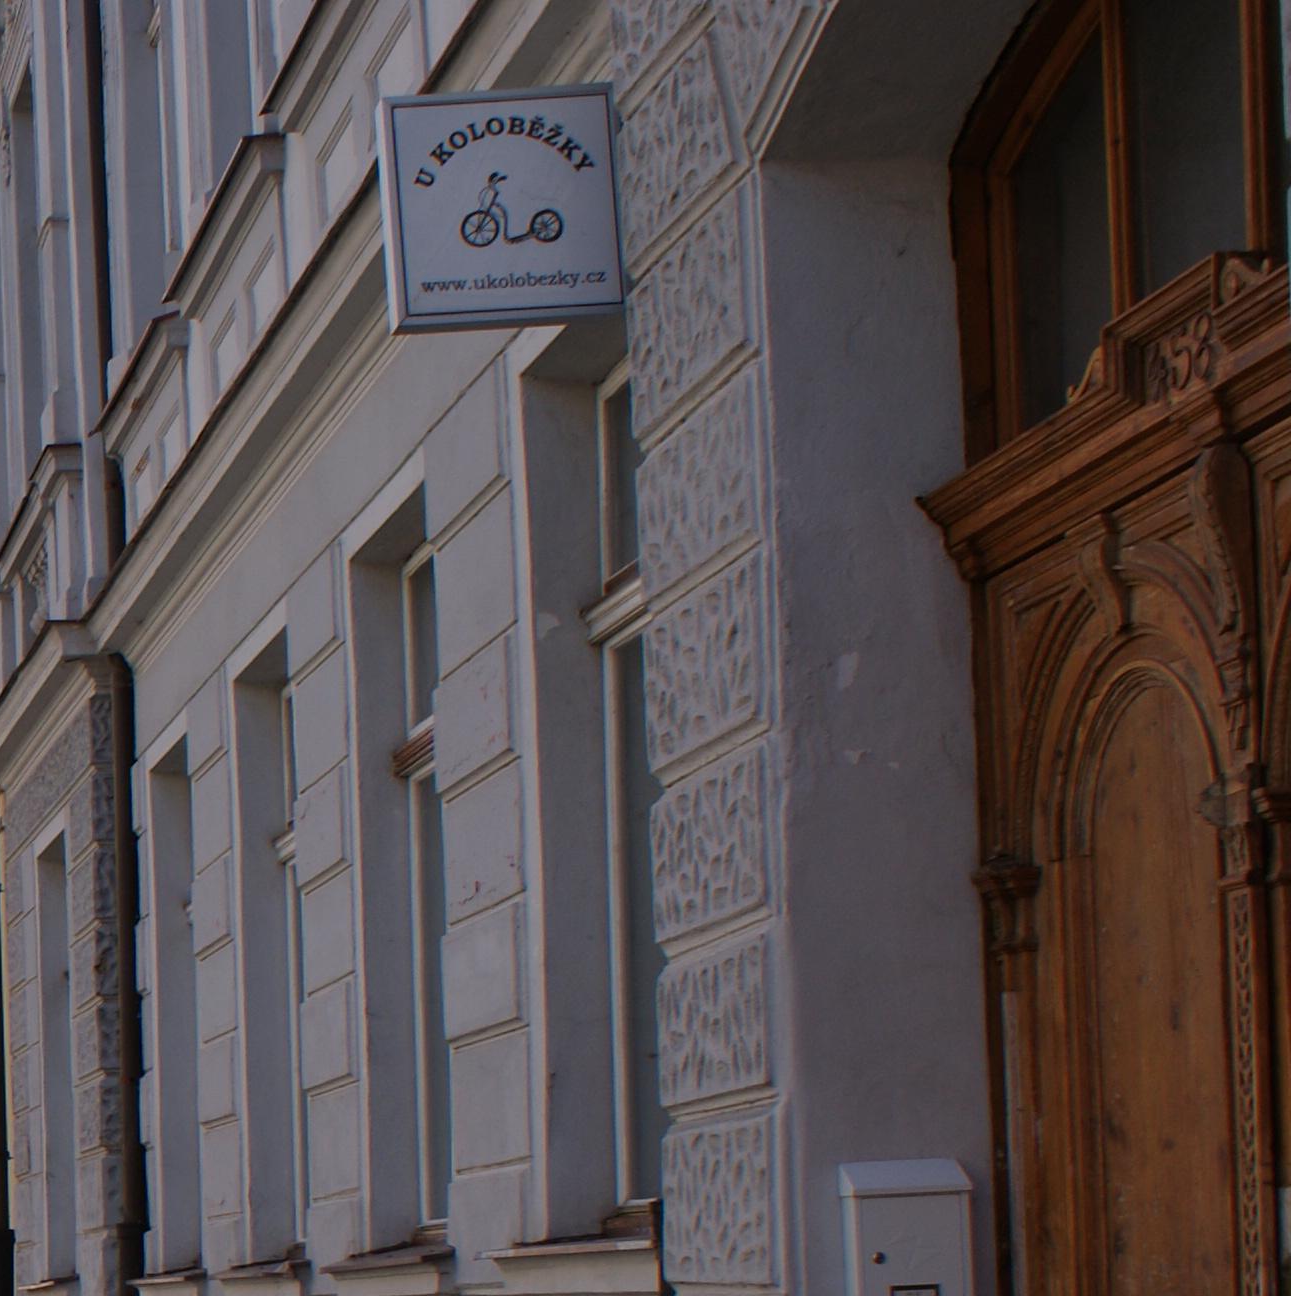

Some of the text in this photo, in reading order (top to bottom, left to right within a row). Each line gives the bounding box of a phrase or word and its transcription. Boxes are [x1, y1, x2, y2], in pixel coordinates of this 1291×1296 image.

[414, 115, 596, 188] U KOLOBĚŽKY
[421, 268, 607, 294] www.ukolobezky.cz
